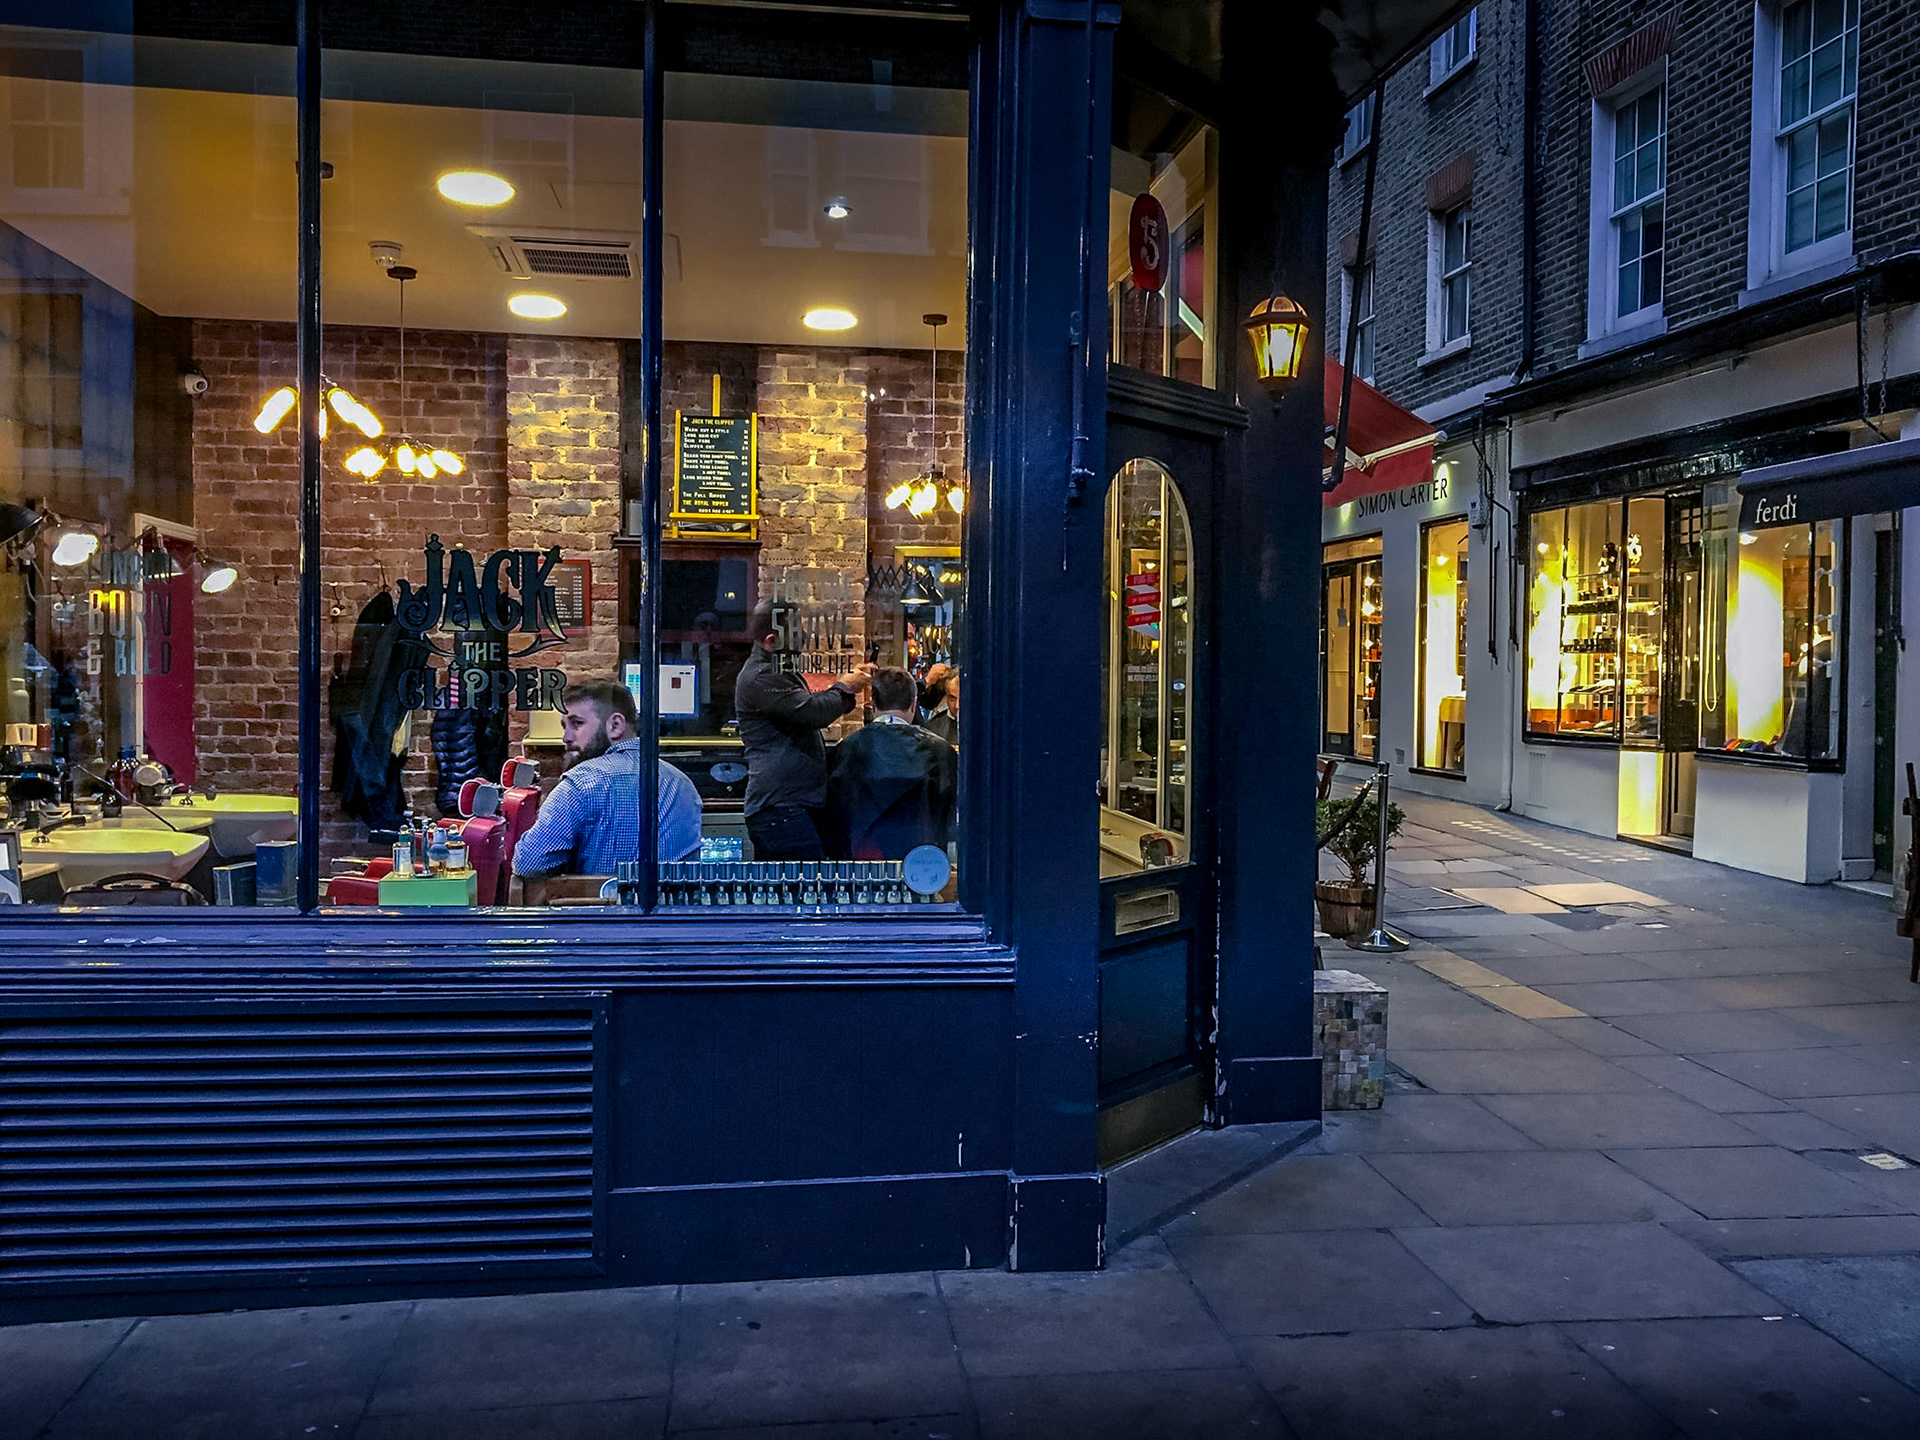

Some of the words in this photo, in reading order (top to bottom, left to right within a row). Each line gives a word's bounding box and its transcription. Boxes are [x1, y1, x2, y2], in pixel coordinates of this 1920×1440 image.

[1140, 214, 1160, 271] 5
[1358, 490, 1396, 518] SIMON
[1400, 478, 1448, 508] CARTER
[1754, 494, 1798, 525] ferdi
[396, 536, 568, 640] JACK
[88, 589, 172, 636] BORN
[772, 608, 854, 651] SHAVE
[114, 640, 172, 676] BLED
[461, 641, 501, 664] THE
[772, 654, 787, 674] OF
[790, 654, 823, 674] YOUR
[828, 654, 855, 674] LIFE
[398, 664, 568, 714] CLIPPER
